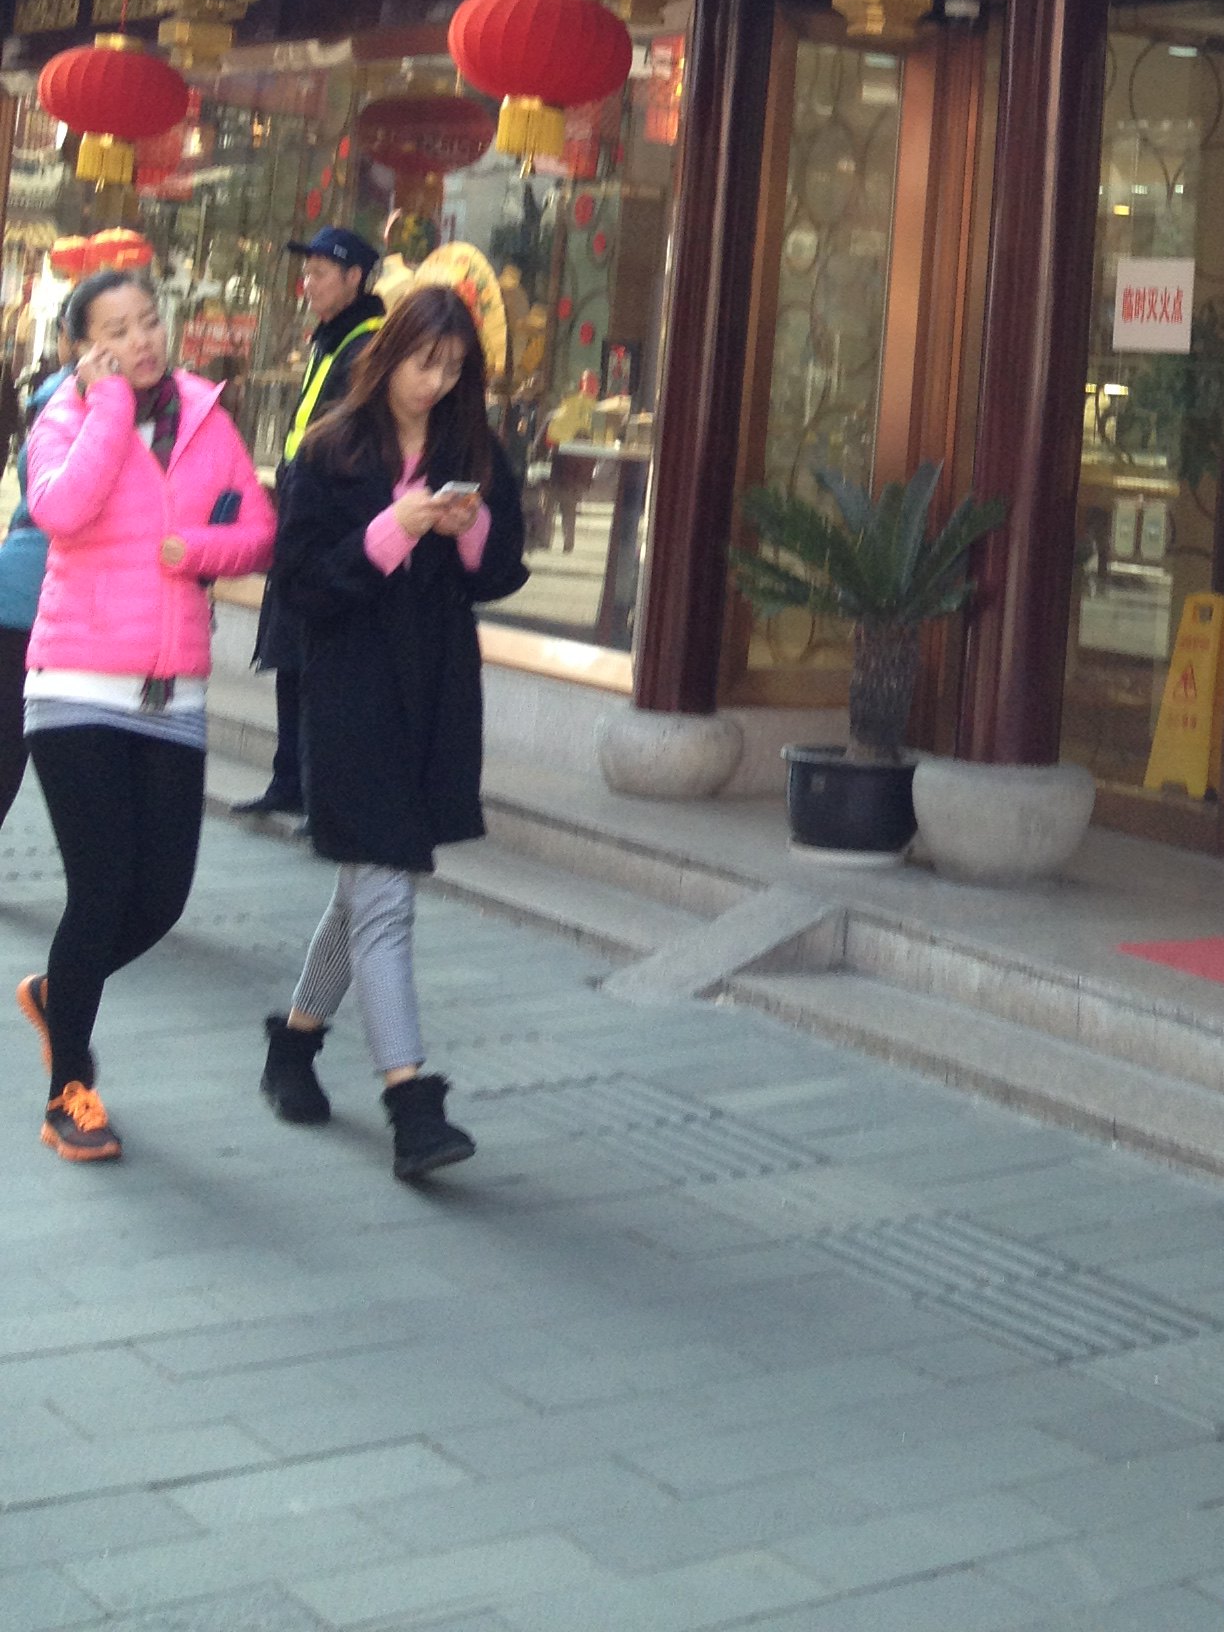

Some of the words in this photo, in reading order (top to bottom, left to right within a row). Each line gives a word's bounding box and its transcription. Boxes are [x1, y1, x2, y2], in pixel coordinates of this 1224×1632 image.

[1121, 284, 1184, 324] 临时灭火点
